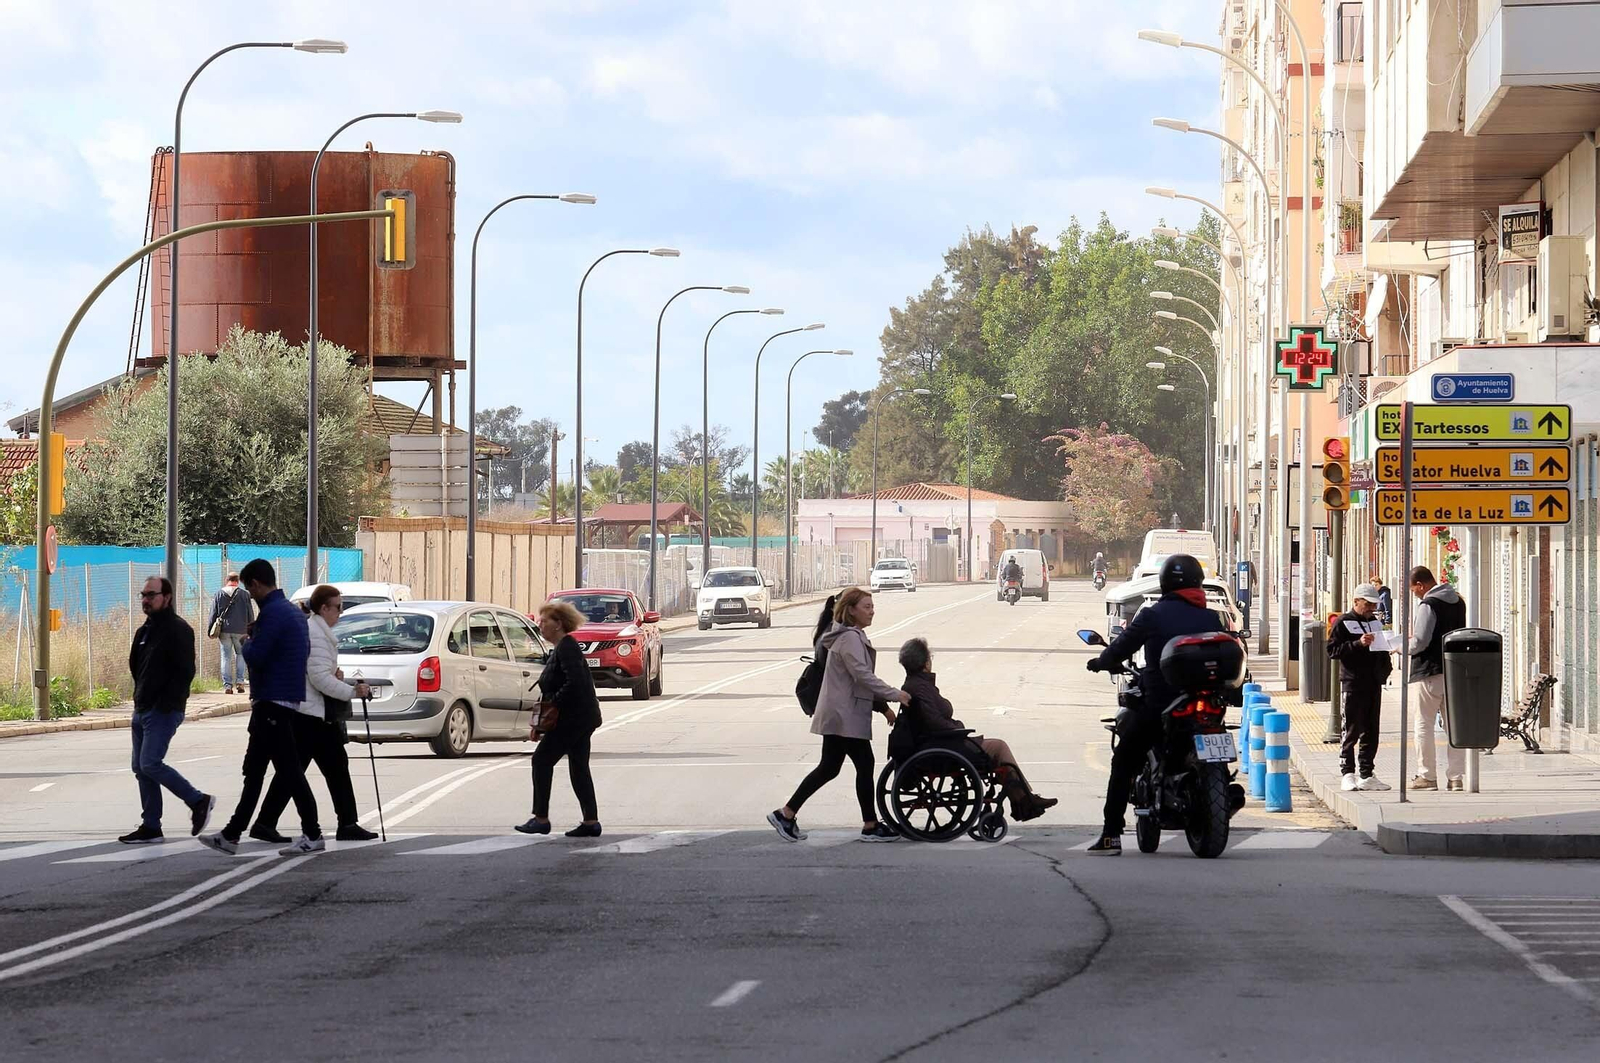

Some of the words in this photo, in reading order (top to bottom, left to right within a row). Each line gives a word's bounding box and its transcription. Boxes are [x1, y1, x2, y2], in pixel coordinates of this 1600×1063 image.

[1503, 218, 1512, 233] SE
[1457, 379, 1509, 388] Ayuntamiento
[1382, 411, 1401, 419] hot
[1414, 422, 1490, 434] Tartessos
[1383, 452, 1417, 462] hol
[1383, 465, 1443, 477] Seator
[1450, 464, 1501, 477] Huelva
[1383, 493, 1417, 502] hotl
[1383, 506, 1427, 519] Cota
[1434, 506, 1452, 519] de
[1458, 506, 1472, 519] la
[1478, 506, 1504, 519] Luz
[1203, 735, 1232, 747] 9016
